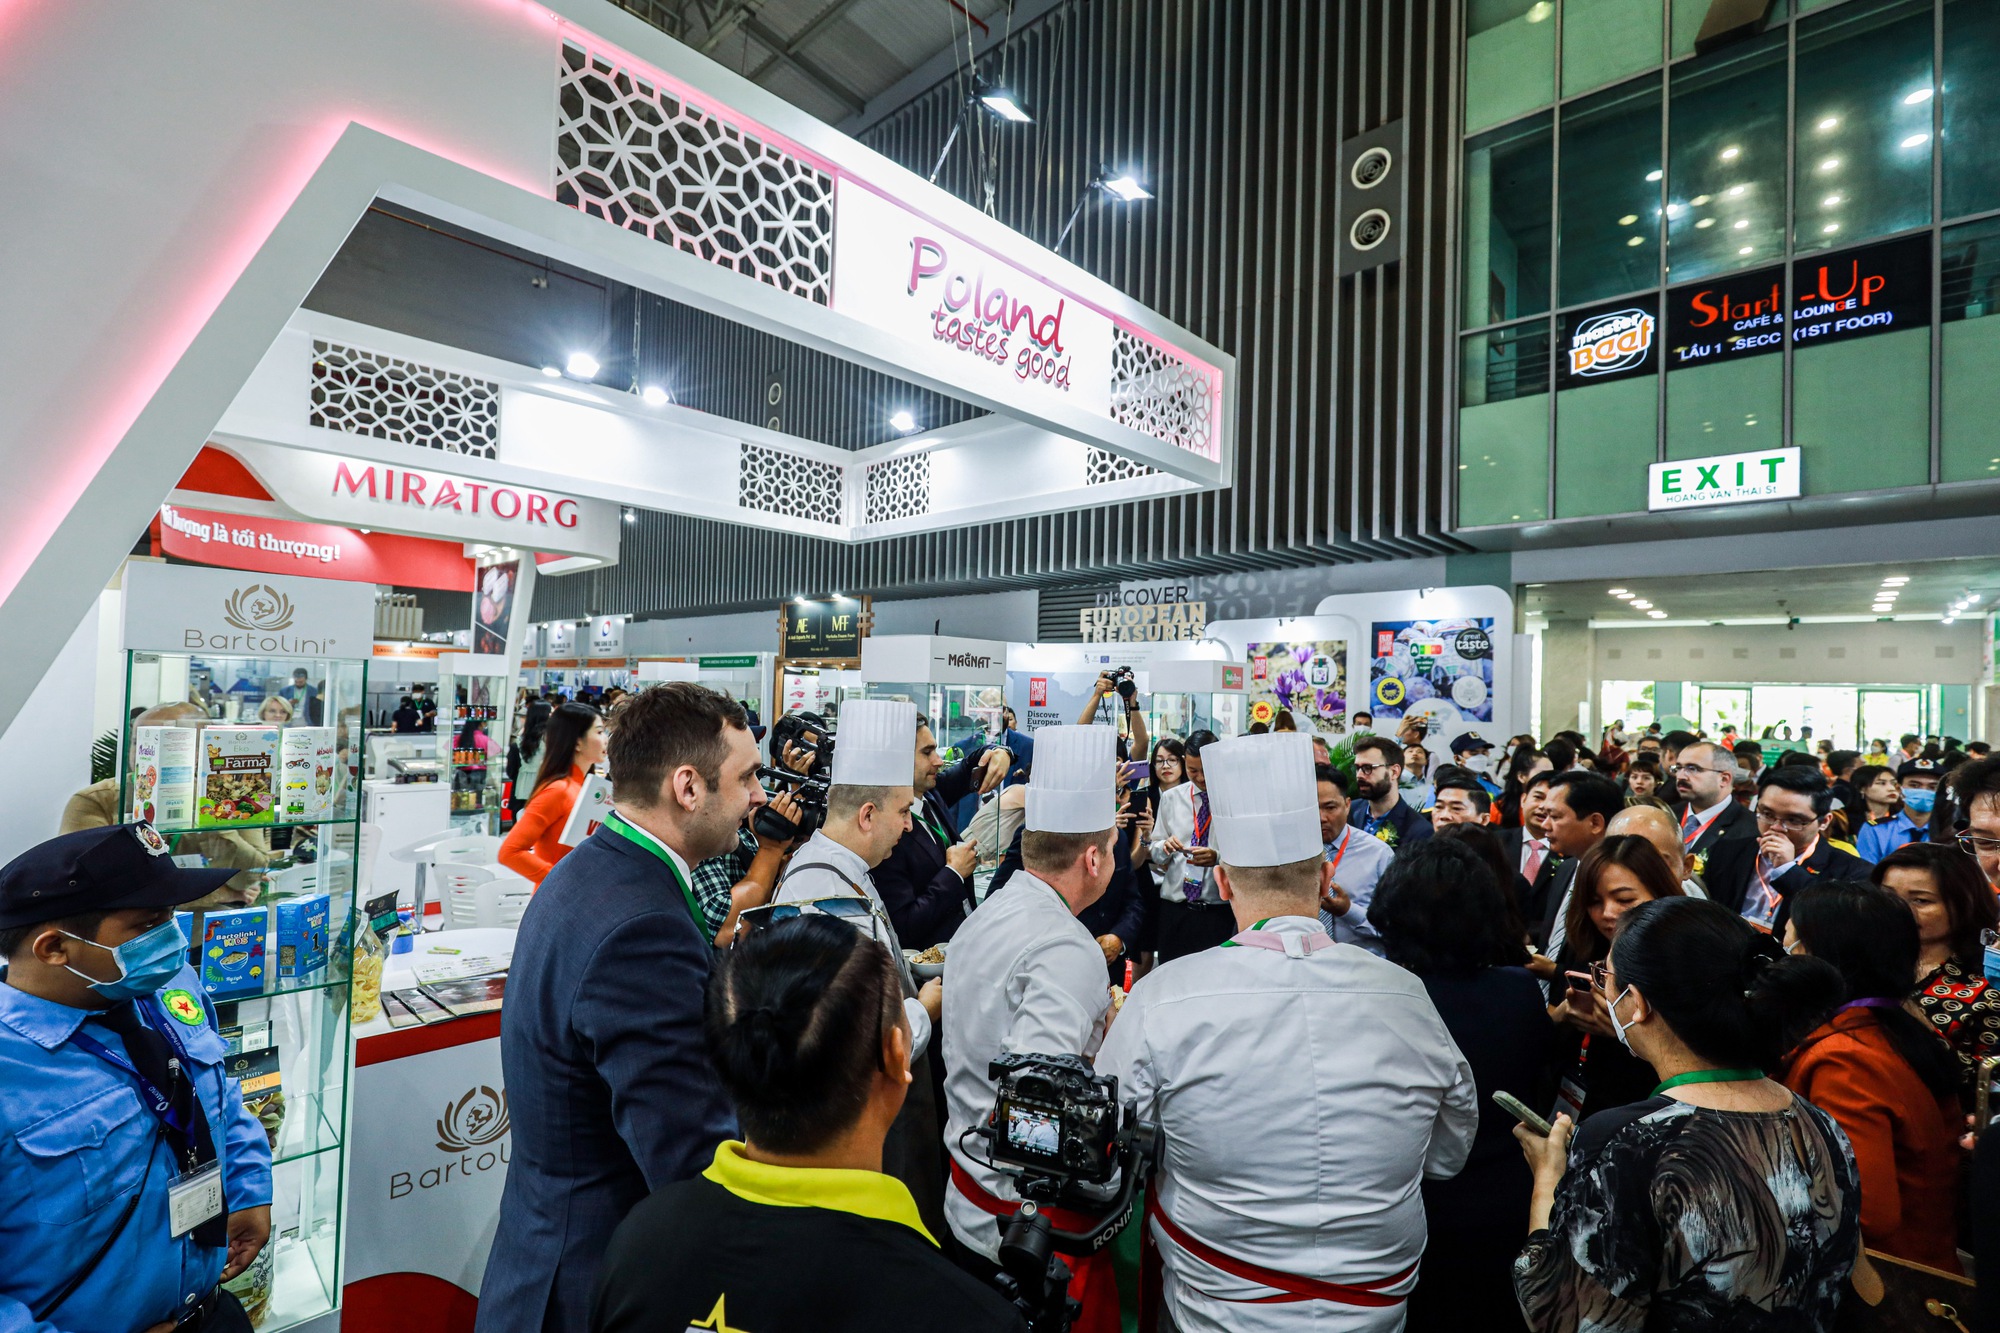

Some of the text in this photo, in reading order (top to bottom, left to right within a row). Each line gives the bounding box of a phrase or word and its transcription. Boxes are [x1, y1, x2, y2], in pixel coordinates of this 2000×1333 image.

[908, 237, 1064, 354] Poland
[1690, 284, 1780, 327] Start
[1773, 313, 1783, 323] &
[1794, 298, 1857, 320] LOUNGE
[1573, 312, 1641, 346] master
[1793, 321, 1833, 342] (1ST
[1835, 311, 1893, 332] FOOR)
[932, 303, 1071, 388] tastes good
[1662, 457, 1786, 494] EXIT
[333, 461, 577, 528] MIRATORG
[1667, 491, 1706, 503] HOANG
[1709, 490, 1731, 499] VAN
[1736, 487, 1762, 496] THAI
[213, 522, 229, 543] là
[1095, 586, 1189, 608] DISCOVER
[1080, 602, 1206, 627] EUROPEAN
[1081, 624, 1206, 643] TREASURES
[1456, 640, 1489, 650] taste
[948, 653, 991, 668] MAGNAT
[1027, 710, 1059, 719] Discover
[1027, 718, 1062, 726] European
[225, 757, 267, 769] Farma
[216, 930, 257, 940] Bartolinki
[390, 1143, 509, 1200] Bartol
[1093, 1201, 1133, 1250] RONIN
